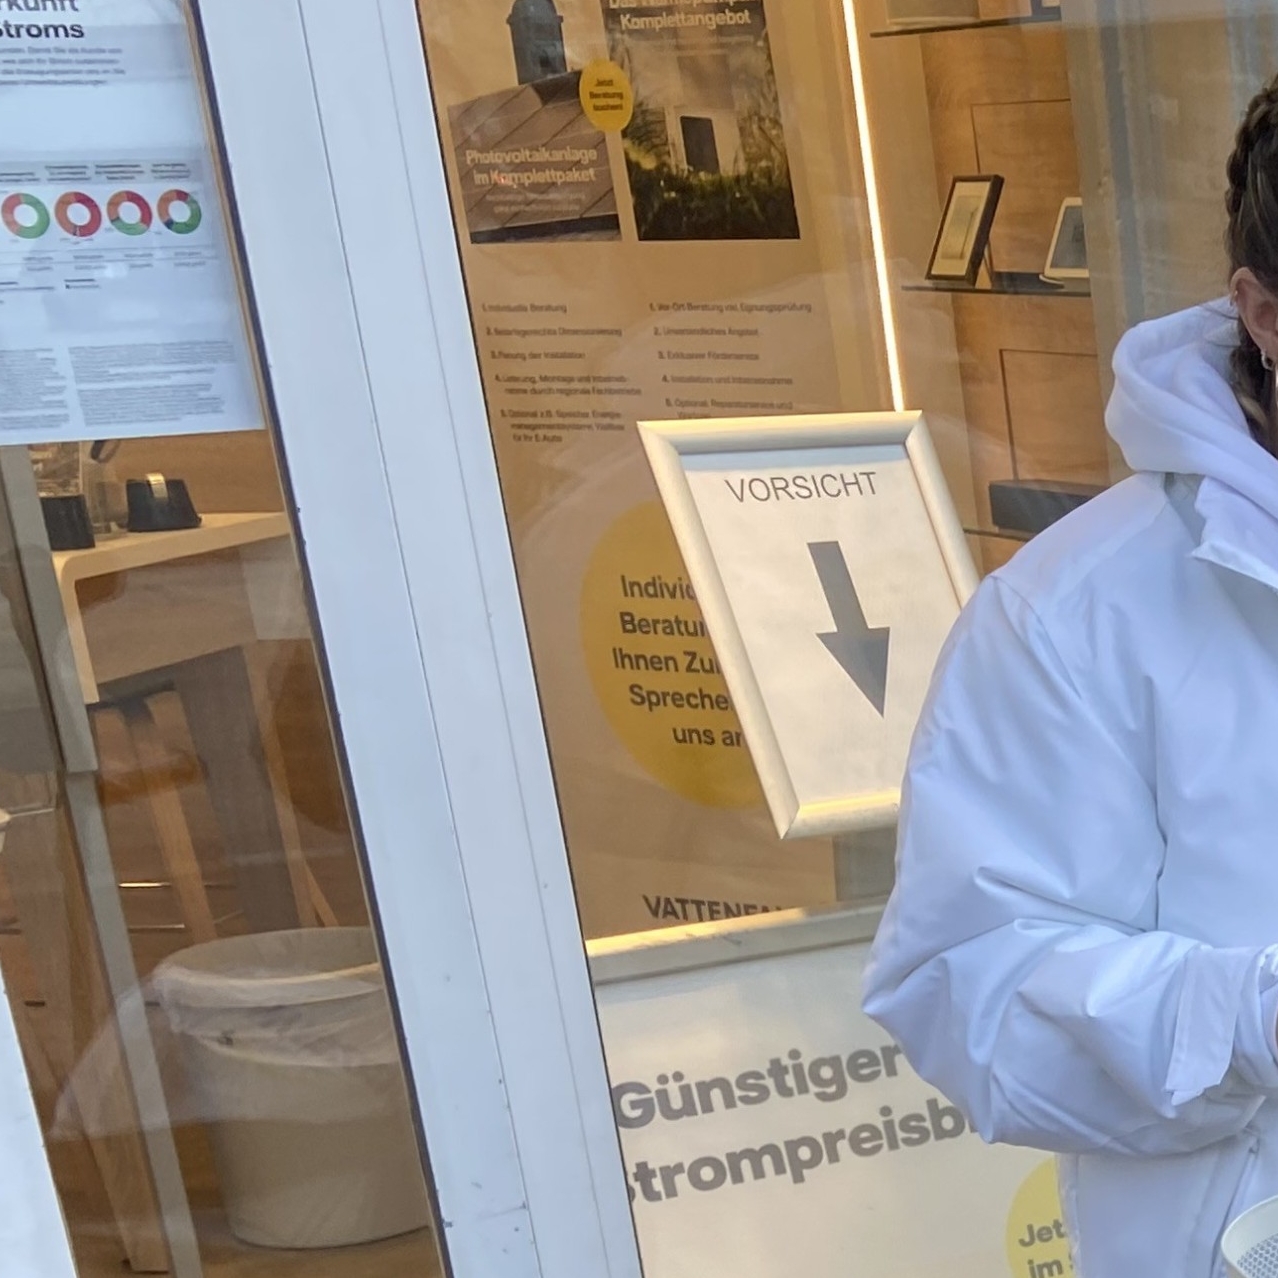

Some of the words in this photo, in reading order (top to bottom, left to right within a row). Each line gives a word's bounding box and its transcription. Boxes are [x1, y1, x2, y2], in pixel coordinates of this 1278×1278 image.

[0, 20, 84, 38] troms
[620, 9, 751, 31] Komplettangebot
[466, 146, 597, 164] Photovoltaikanlage
[473, 170, 489, 185] im
[491, 168, 596, 186] Komplettpaket
[725, 471, 878, 503] VORSICHT
[613, 648, 678, 672] Ihnen
[629, 683, 735, 712] Spreche
[673, 727, 715, 745] uns
[642, 894, 782, 922] VATTENF
[611, 1044, 903, 1129] Günstiger
[627, 1098, 978, 1203] trompreisb
[1018, 1219, 1066, 1248] Jet
